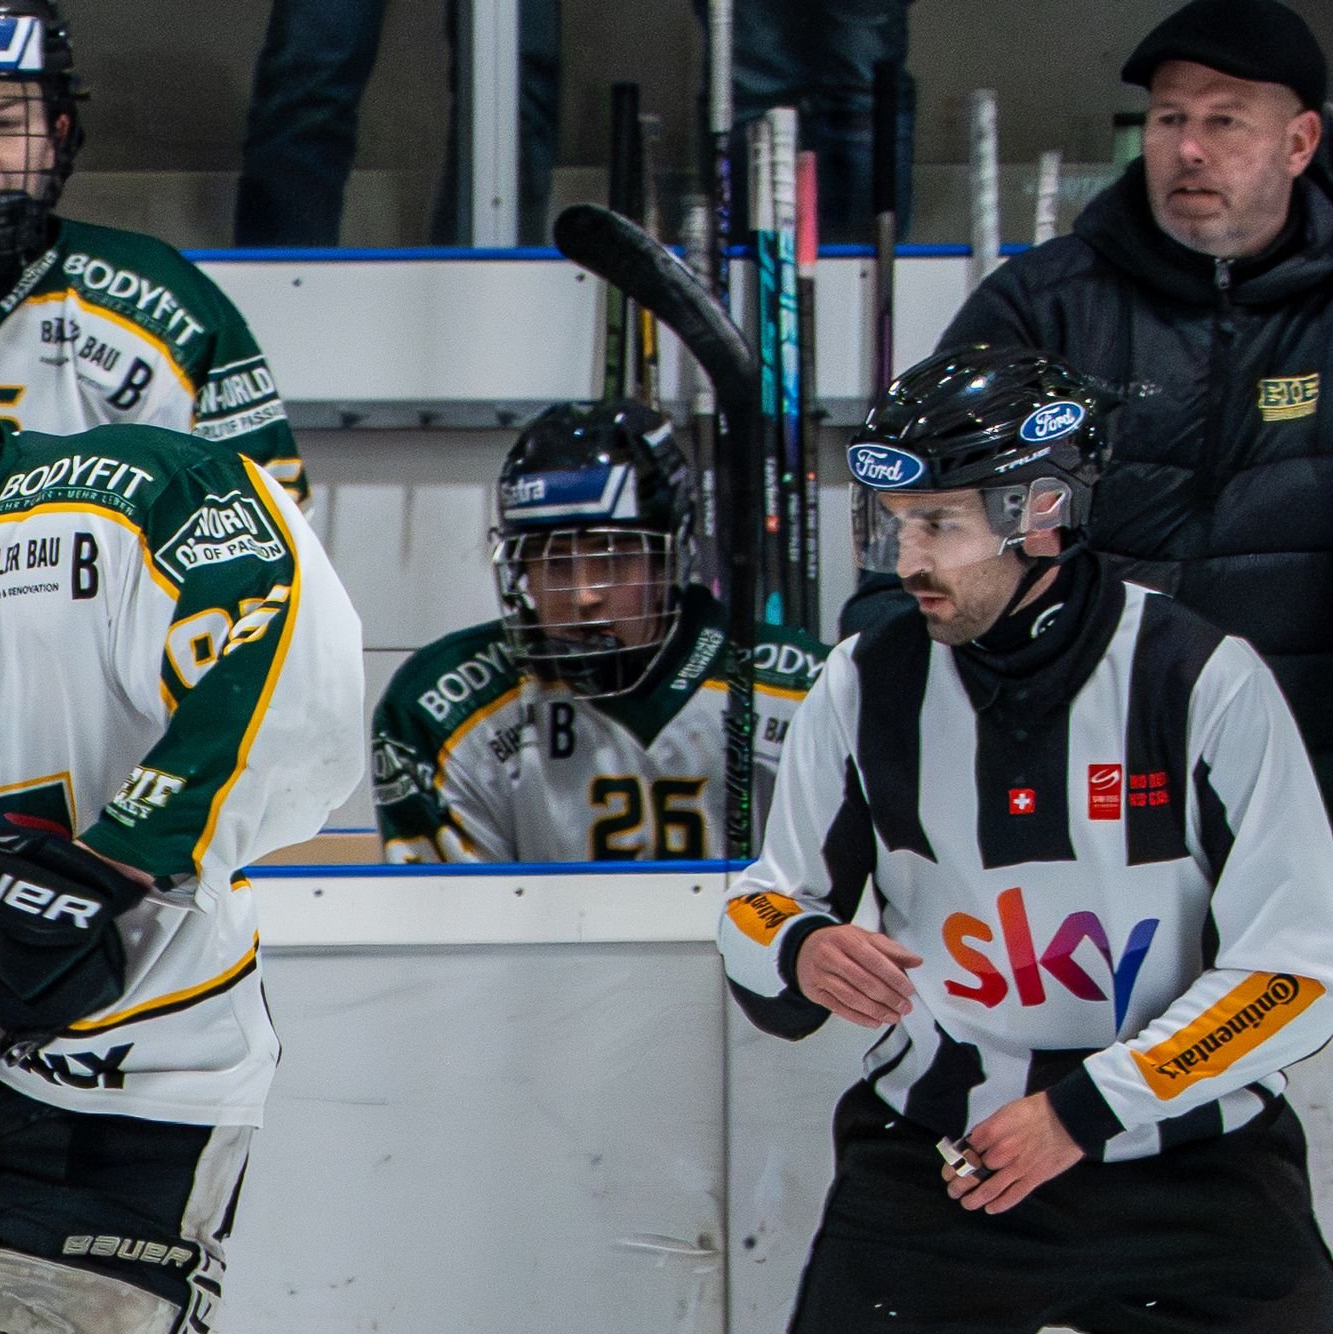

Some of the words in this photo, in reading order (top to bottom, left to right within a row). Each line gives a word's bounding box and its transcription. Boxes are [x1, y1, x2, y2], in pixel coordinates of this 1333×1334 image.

[62, 252, 205, 346] BODYFIT
[78, 336, 121, 373] BAU
[1035, 407, 1076, 437] Ford
[856, 449, 904, 482] Ford
[27, 537, 60, 569] BAU
[71, 532, 99, 601] B
[550, 702, 575, 759] B
[589, 775, 709, 862] 26
[941, 886, 1160, 1038] sky
[62, 1235, 193, 1268] BAUER
